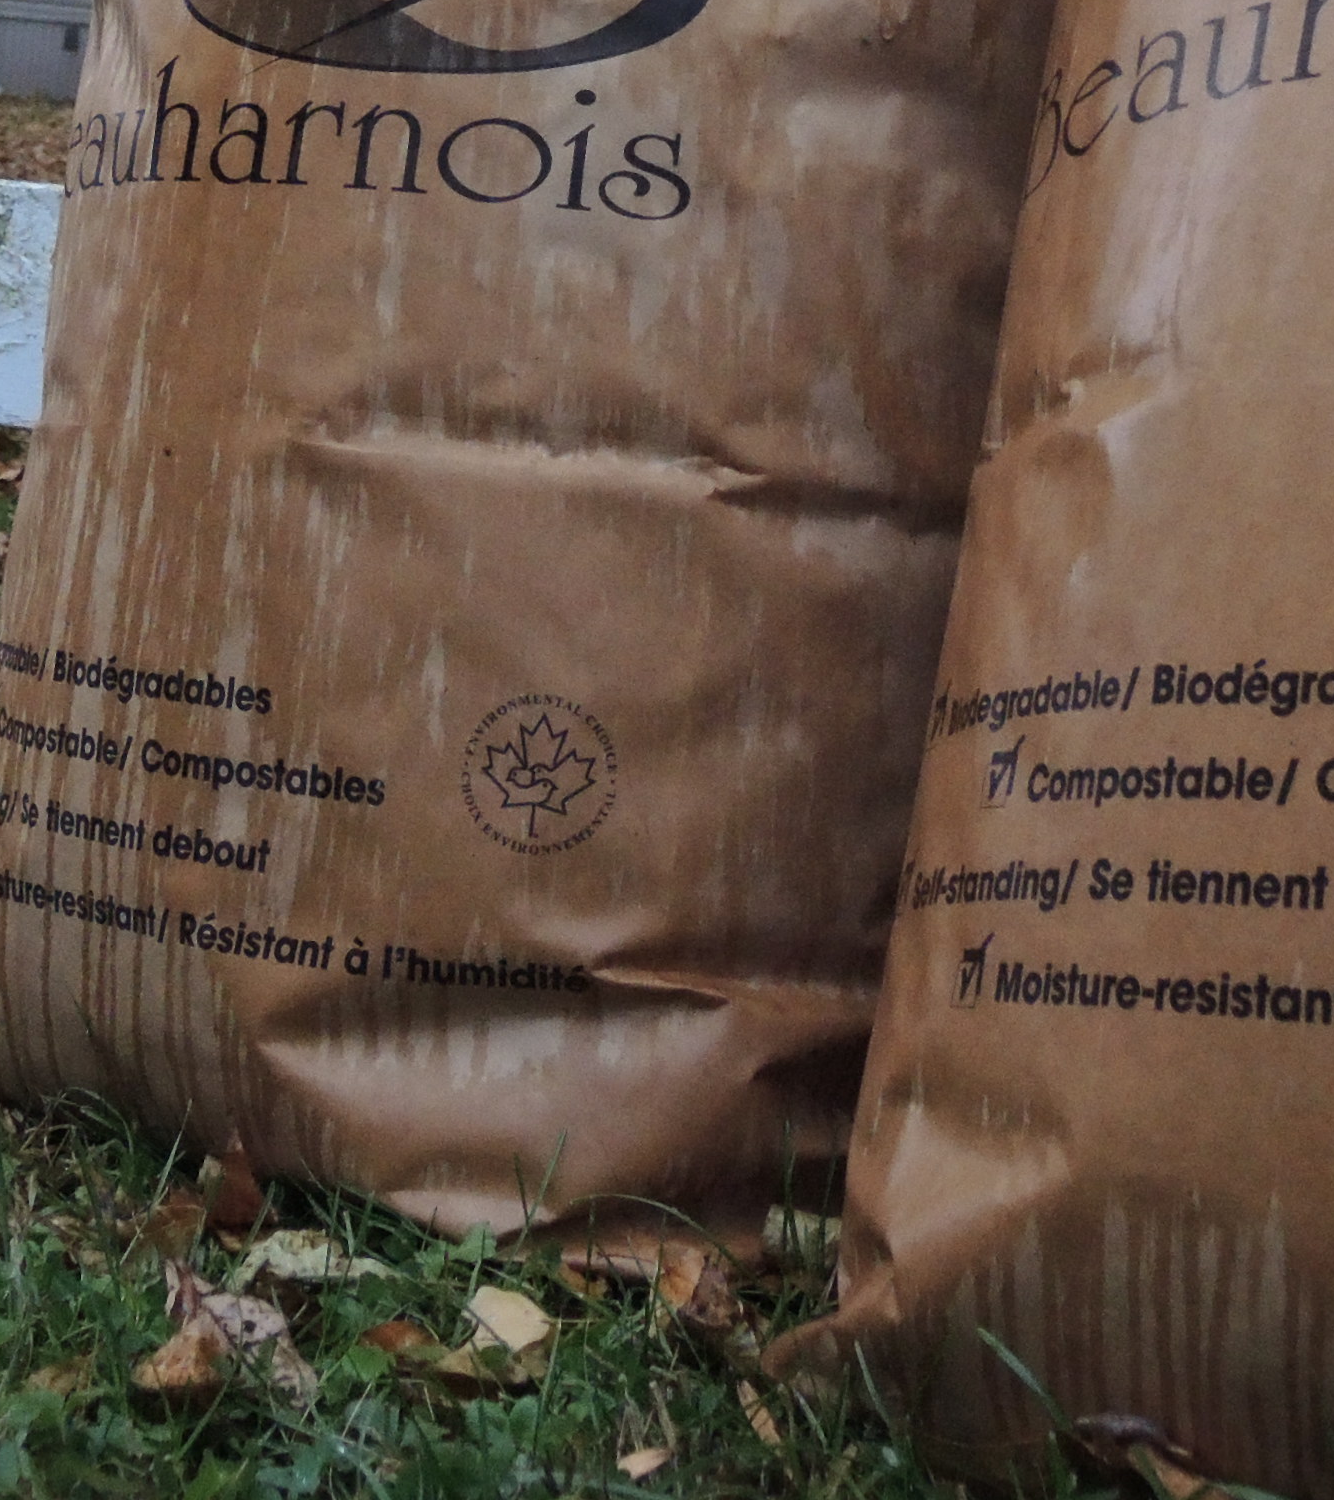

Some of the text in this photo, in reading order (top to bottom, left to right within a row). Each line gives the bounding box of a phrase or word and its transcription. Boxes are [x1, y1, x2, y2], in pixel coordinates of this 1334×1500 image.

[64, 54, 692, 221] eauharnois
[53, 650, 273, 715] Biodégradables
[140, 739, 387, 807] Compostables
[1026, 756, 1299, 809] Compostable/
[21, 792, 40, 829] Se
[46, 798, 146, 852] tiennent
[152, 823, 271, 874] debout
[1088, 858, 1134, 902] Se
[1147, 860, 1329, 911] tiennent
[178, 911, 335, 970] Résistant
[344, 940, 369, 977] à
[382, 945, 592, 995] l'humidité
